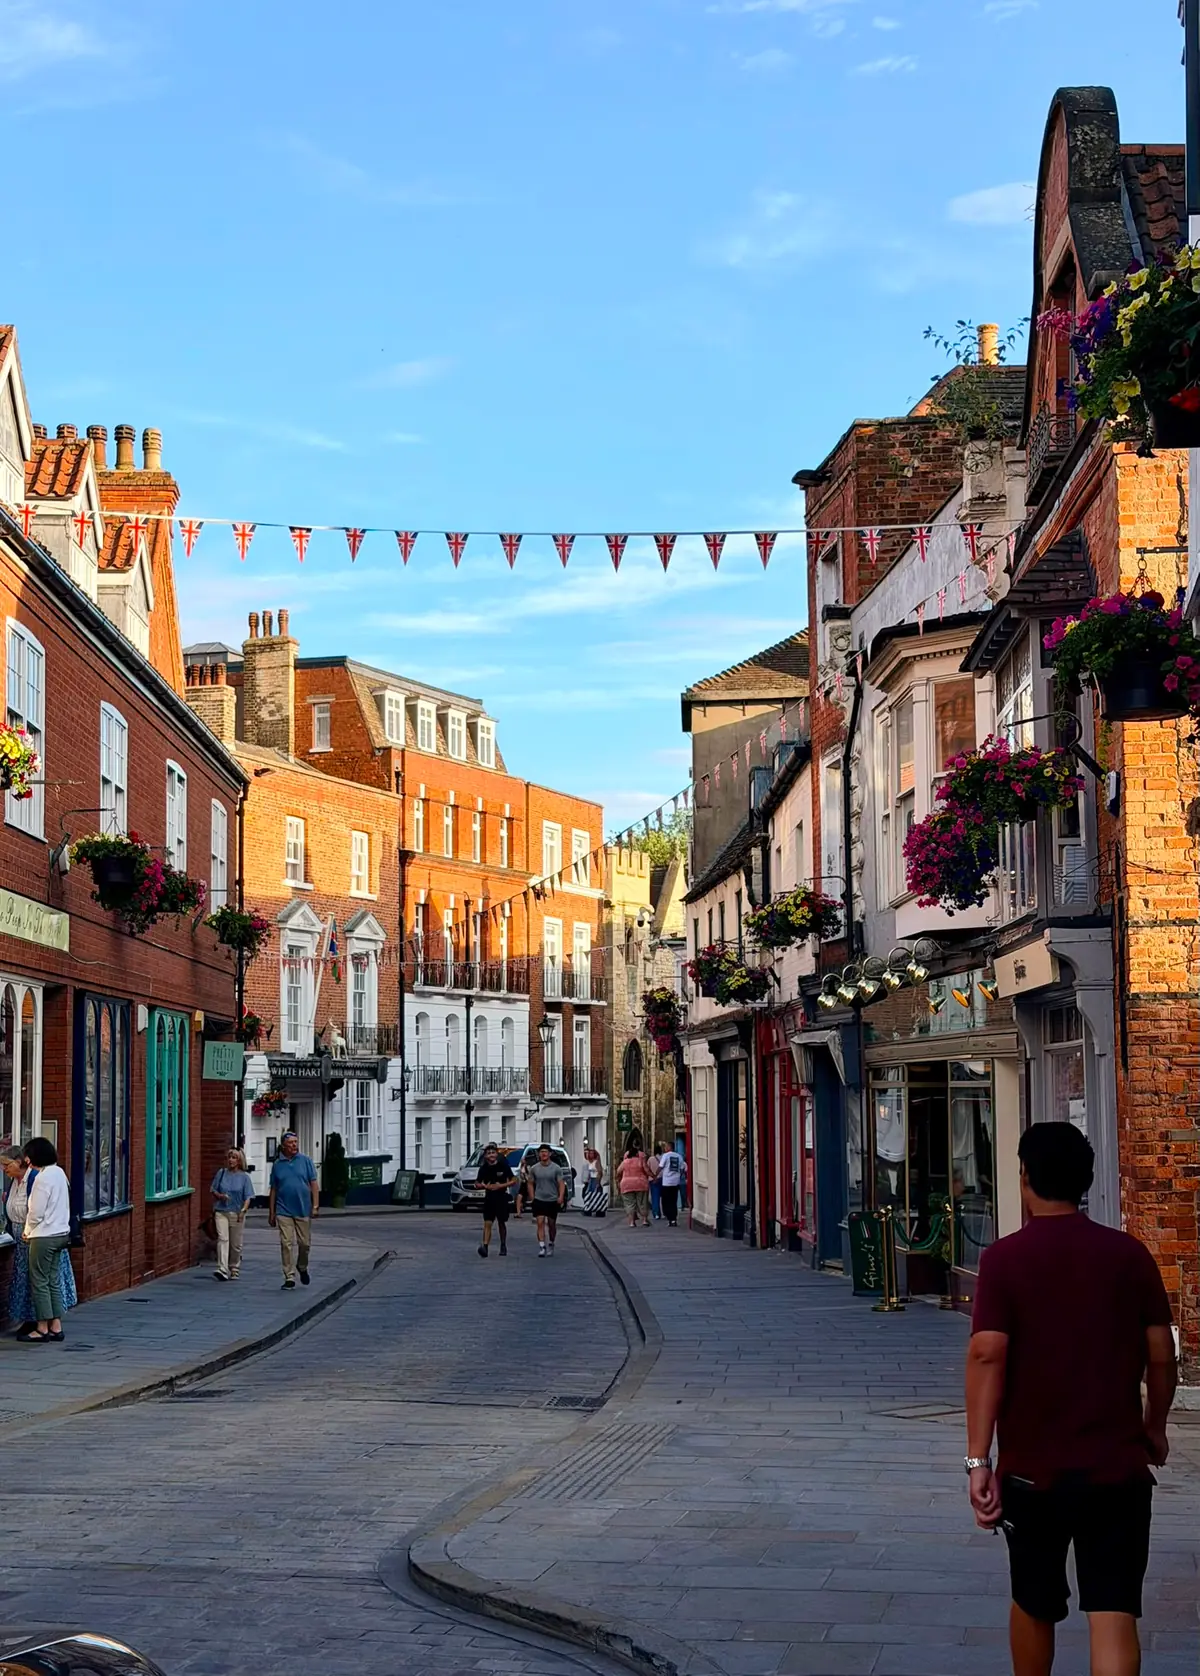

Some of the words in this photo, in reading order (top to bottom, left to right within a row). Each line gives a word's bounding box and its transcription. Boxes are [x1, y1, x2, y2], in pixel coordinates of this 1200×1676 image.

[212, 1046, 234, 1058] PRETTY
[212, 1059, 234, 1071] LITTLE
[271, 1066, 298, 1077] WHITE
[298, 1067, 321, 1077] HART
[861, 1240, 879, 1288] Gino's
